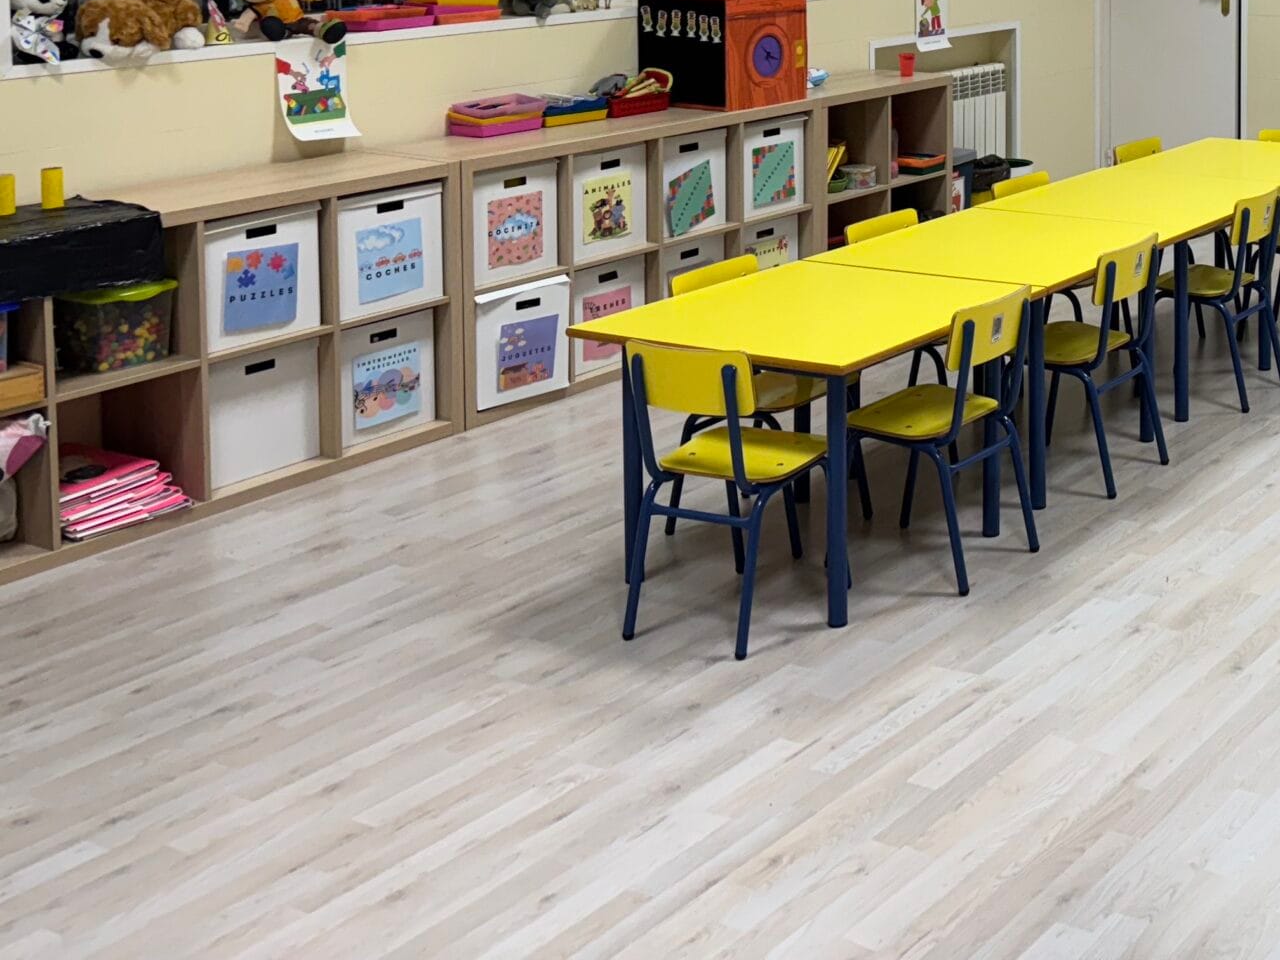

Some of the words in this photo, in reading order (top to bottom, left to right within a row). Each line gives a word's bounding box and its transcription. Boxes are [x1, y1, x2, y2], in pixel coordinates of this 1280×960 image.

[583, 179, 631, 195] ANIMALES
[488, 220, 540, 238] COCINITA
[366, 262, 416, 281] COCHES
[229, 286, 294, 303] PUZZLES
[501, 345, 552, 362] JUGUETES
